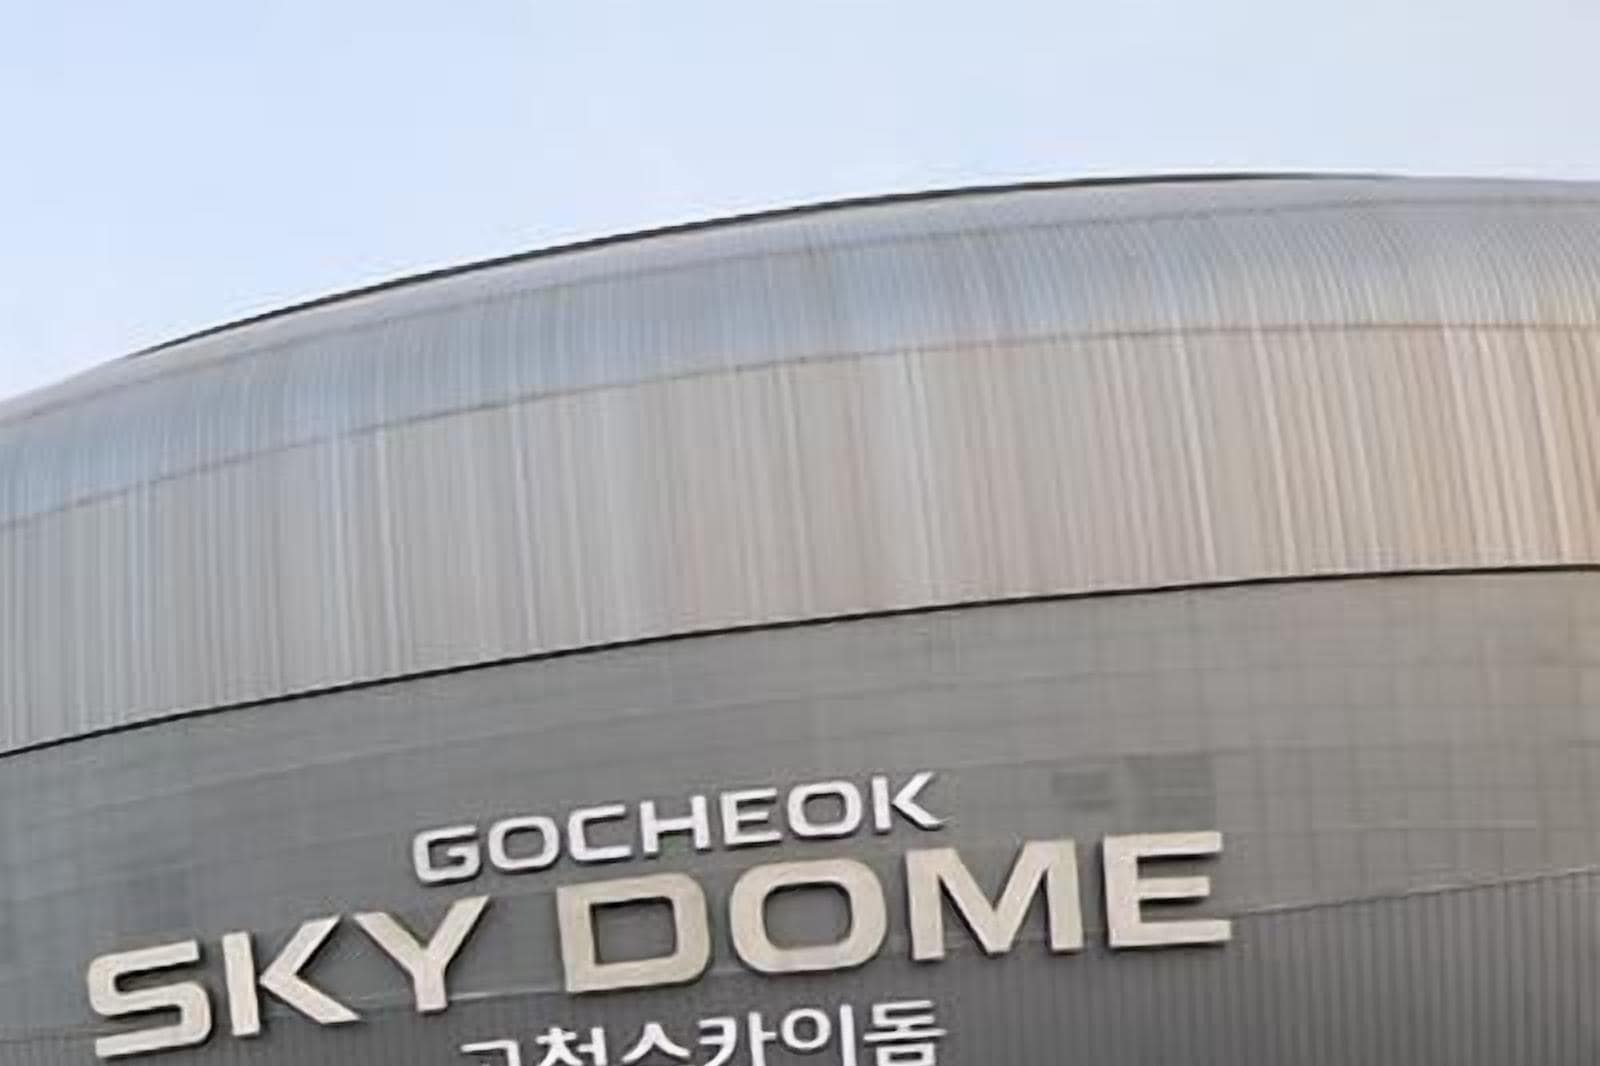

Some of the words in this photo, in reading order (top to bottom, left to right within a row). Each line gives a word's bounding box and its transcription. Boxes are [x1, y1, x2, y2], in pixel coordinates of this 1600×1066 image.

[413, 771, 945, 885] GOCHEOK
[88, 894, 491, 1058] SKY
[558, 830, 1232, 994] DOME
